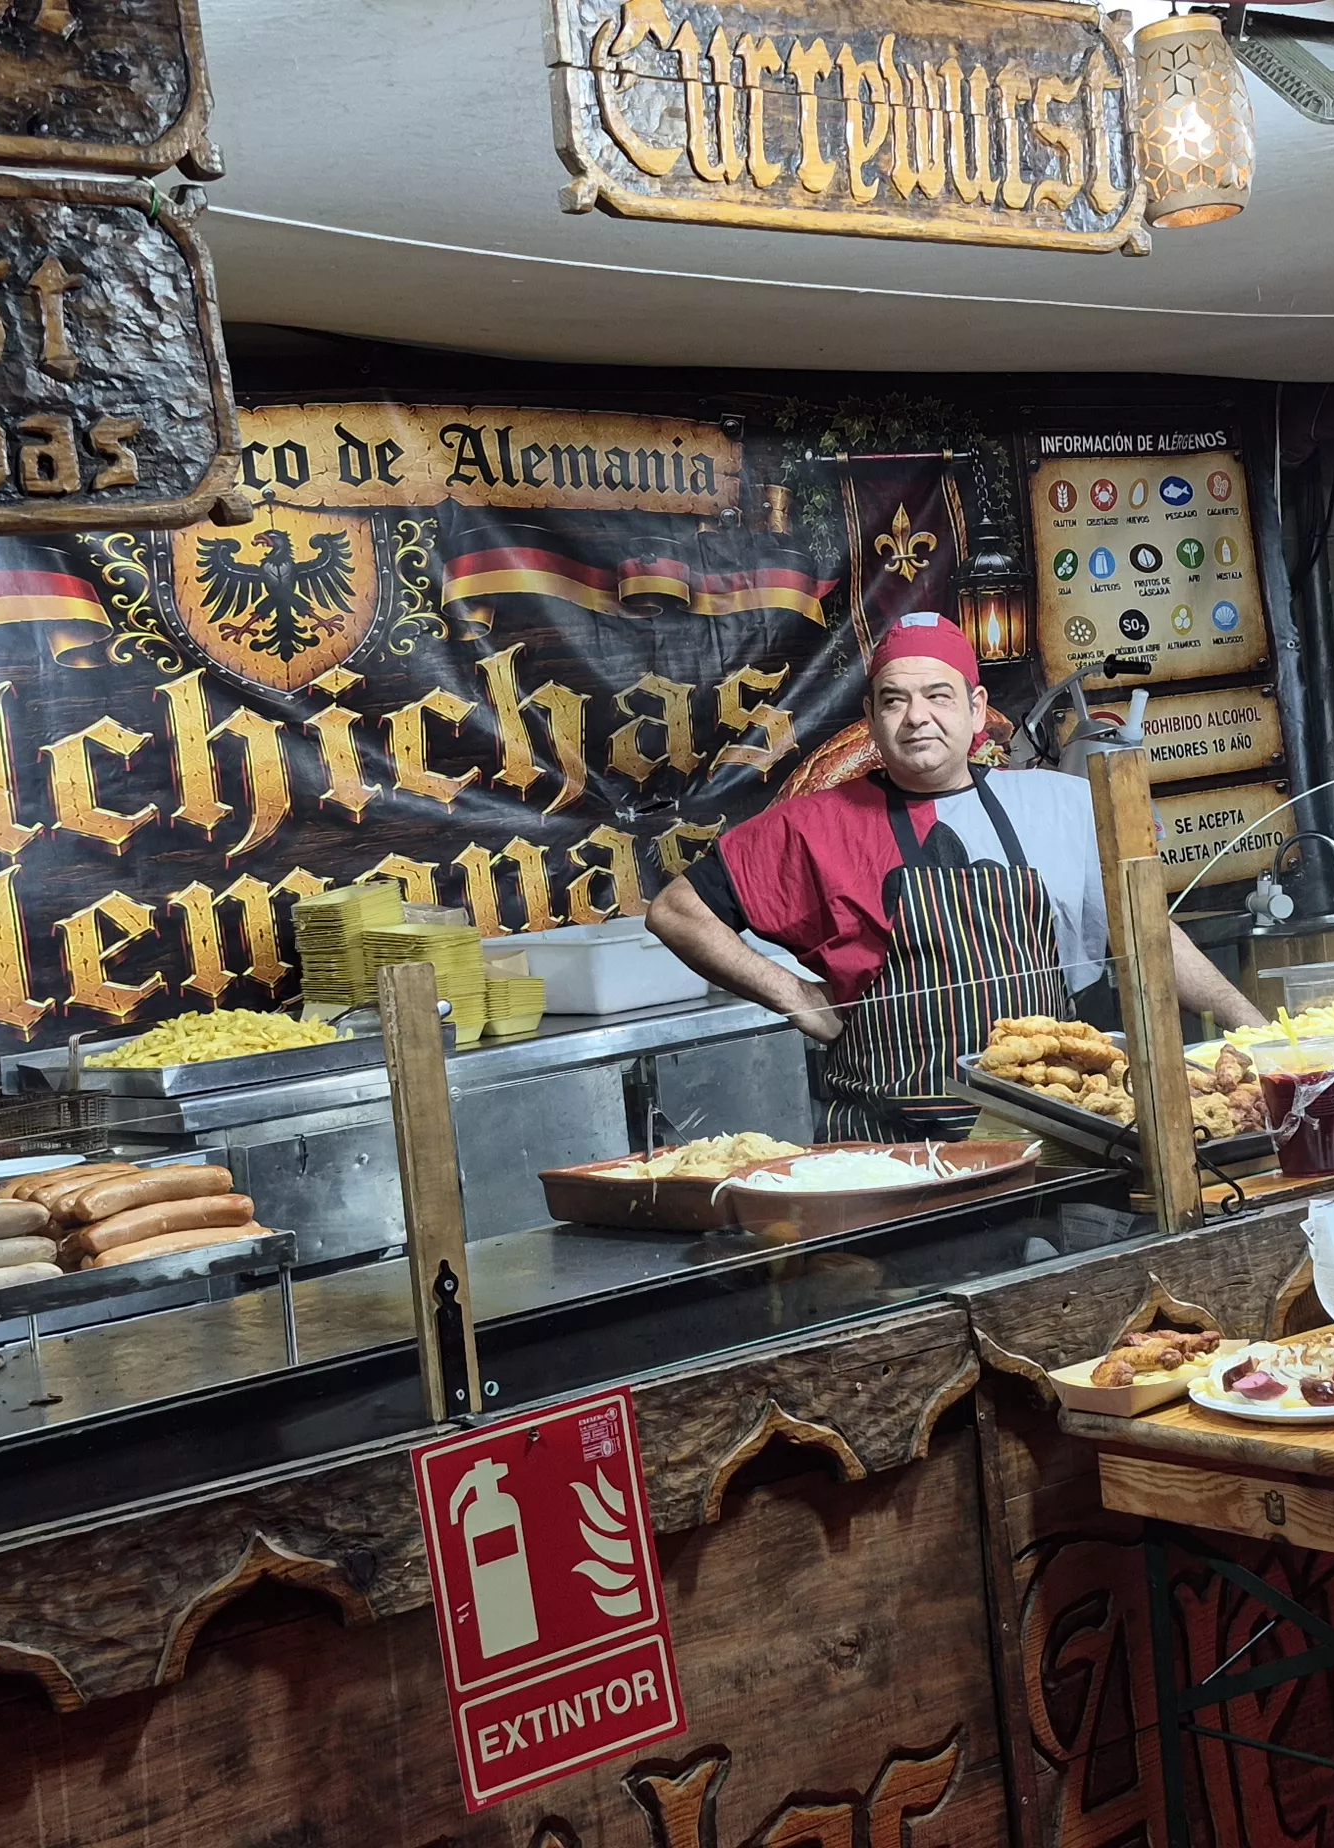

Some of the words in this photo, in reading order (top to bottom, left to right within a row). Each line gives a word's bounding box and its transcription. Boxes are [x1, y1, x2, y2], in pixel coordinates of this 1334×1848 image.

[1040, 430, 1133, 454] INFORMACIÓN
[1137, 434, 1153, 451] DE
[1158, 430, 1228, 452] ALÉRGENOS
[332, 421, 406, 486] de
[439, 421, 720, 498] Alemania
[1165, 509, 1198, 520] PESCADO
[1090, 582, 1121, 593] LÁCTEOS
[1134, 578, 1160, 588] FRUTOS
[1161, 577, 1171, 586] DE
[1096, 650, 1106, 658] DE
[1141, 712, 1202, 737] ROHIBIDO
[1207, 706, 1262, 728] ALCOHOL
[1150, 739, 1209, 763] MENORES
[1212, 738, 1226, 753] 18
[1230, 732, 1252, 751] AÑO
[1174, 816, 1193, 834] SE
[1198, 809, 1245, 831] ACEPTA
[1159, 843, 1211, 866] ARJETA
[1213, 839, 1229, 856] DE
[1232, 831, 1284, 854] CRÉDITO
[478, 1669, 660, 1763] EXTINTOR
